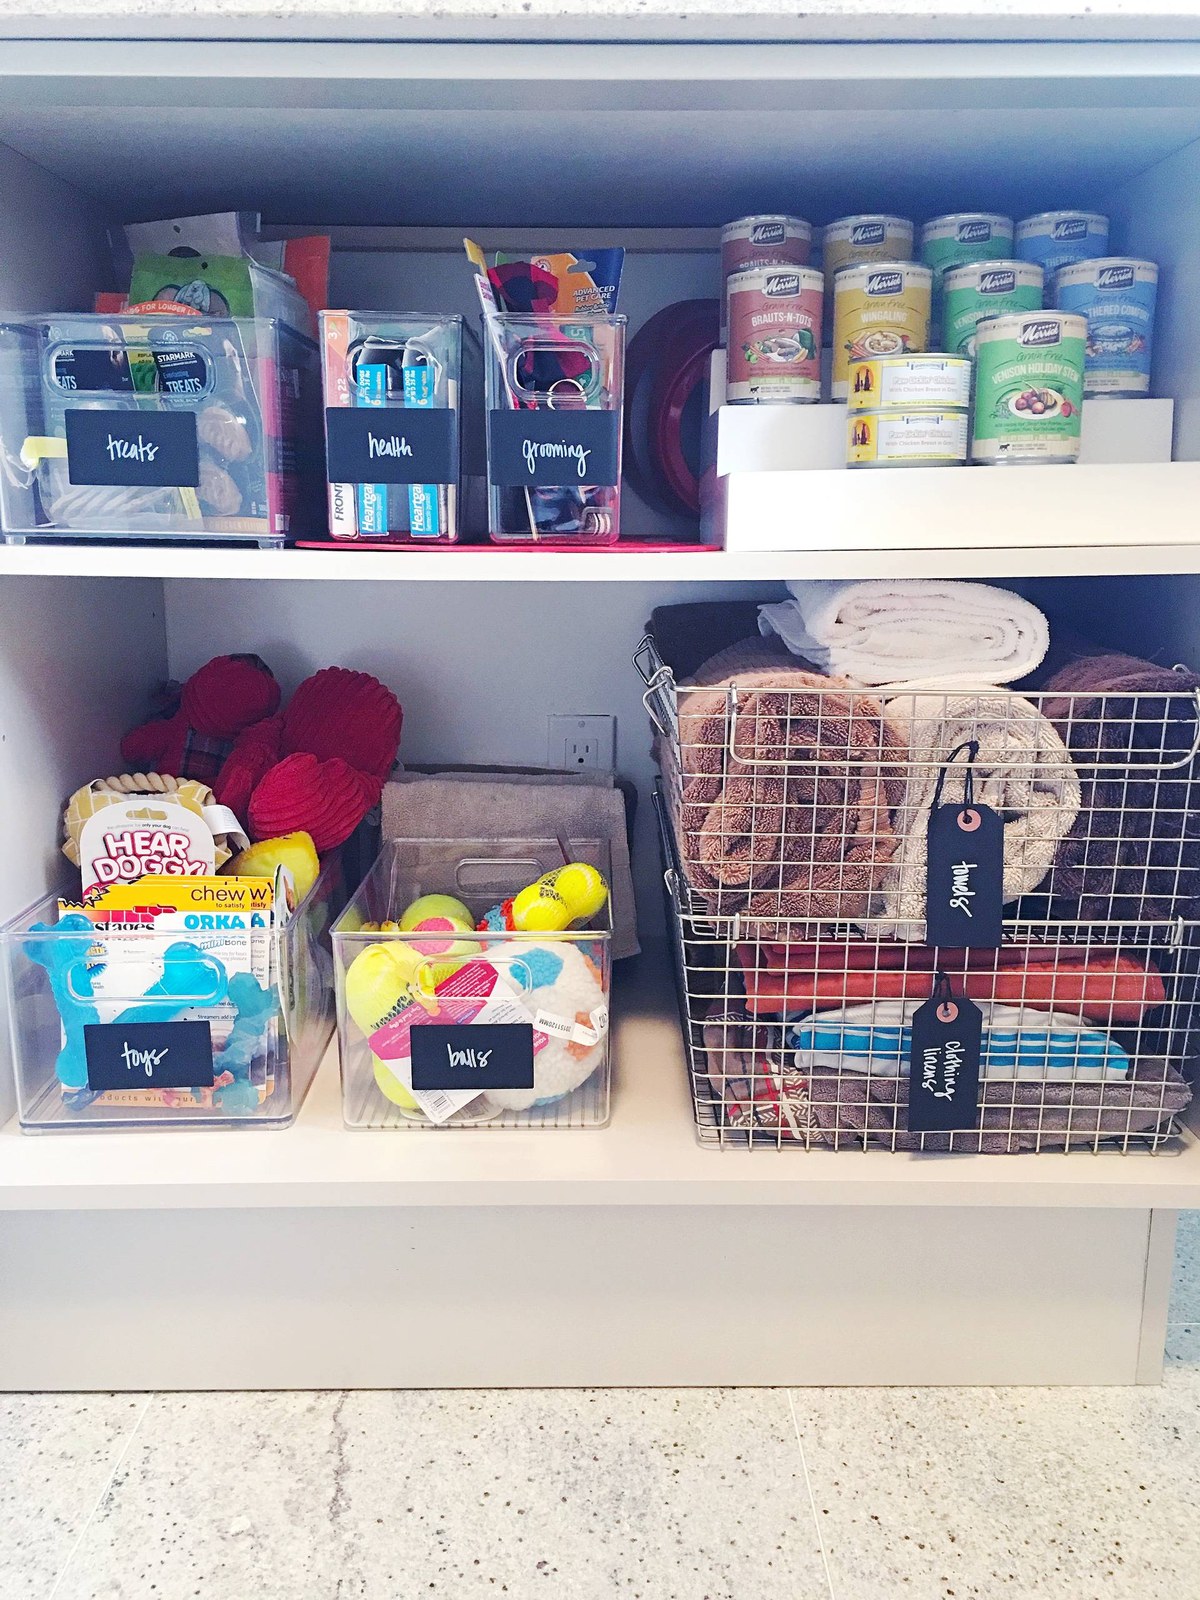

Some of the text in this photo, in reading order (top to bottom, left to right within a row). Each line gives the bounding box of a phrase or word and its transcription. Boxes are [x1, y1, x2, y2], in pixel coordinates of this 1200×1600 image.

[761, 279, 799, 295] Merrick
[864, 278, 901, 294] Merrick
[976, 273, 1014, 291] Merrick
[1094, 270, 1132, 287] Merrick
[572, 285, 616, 297] ADVANCED
[575, 291, 612, 303] PET CARE
[751, 312, 813, 328] BRAUTS-N-TOTS
[860, 311, 907, 323] WINGALING
[1017, 324, 1059, 343] Merrick
[157, 351, 196, 363] STARMARK
[1016, 352, 1042, 362] Grain
[991, 365, 1027, 384] VENISON
[1028, 363, 1062, 376] HOLIDAY
[1061, 368, 1079, 382] STEW
[165, 377, 202, 393] TREATS
[107, 434, 159, 462] treats
[368, 432, 413, 458] health
[522, 439, 591, 477] grooming
[103, 831, 190, 859] HEAR
[92, 855, 207, 884] DOGGY!
[191, 886, 245, 901] chew
[949, 860, 978, 918] towels
[224, 902, 245, 910] satisfy
[184, 914, 246, 930] ORKA
[121, 1041, 169, 1077] toys
[447, 1043, 493, 1068] balls
[921, 1047, 942, 1092] linens
